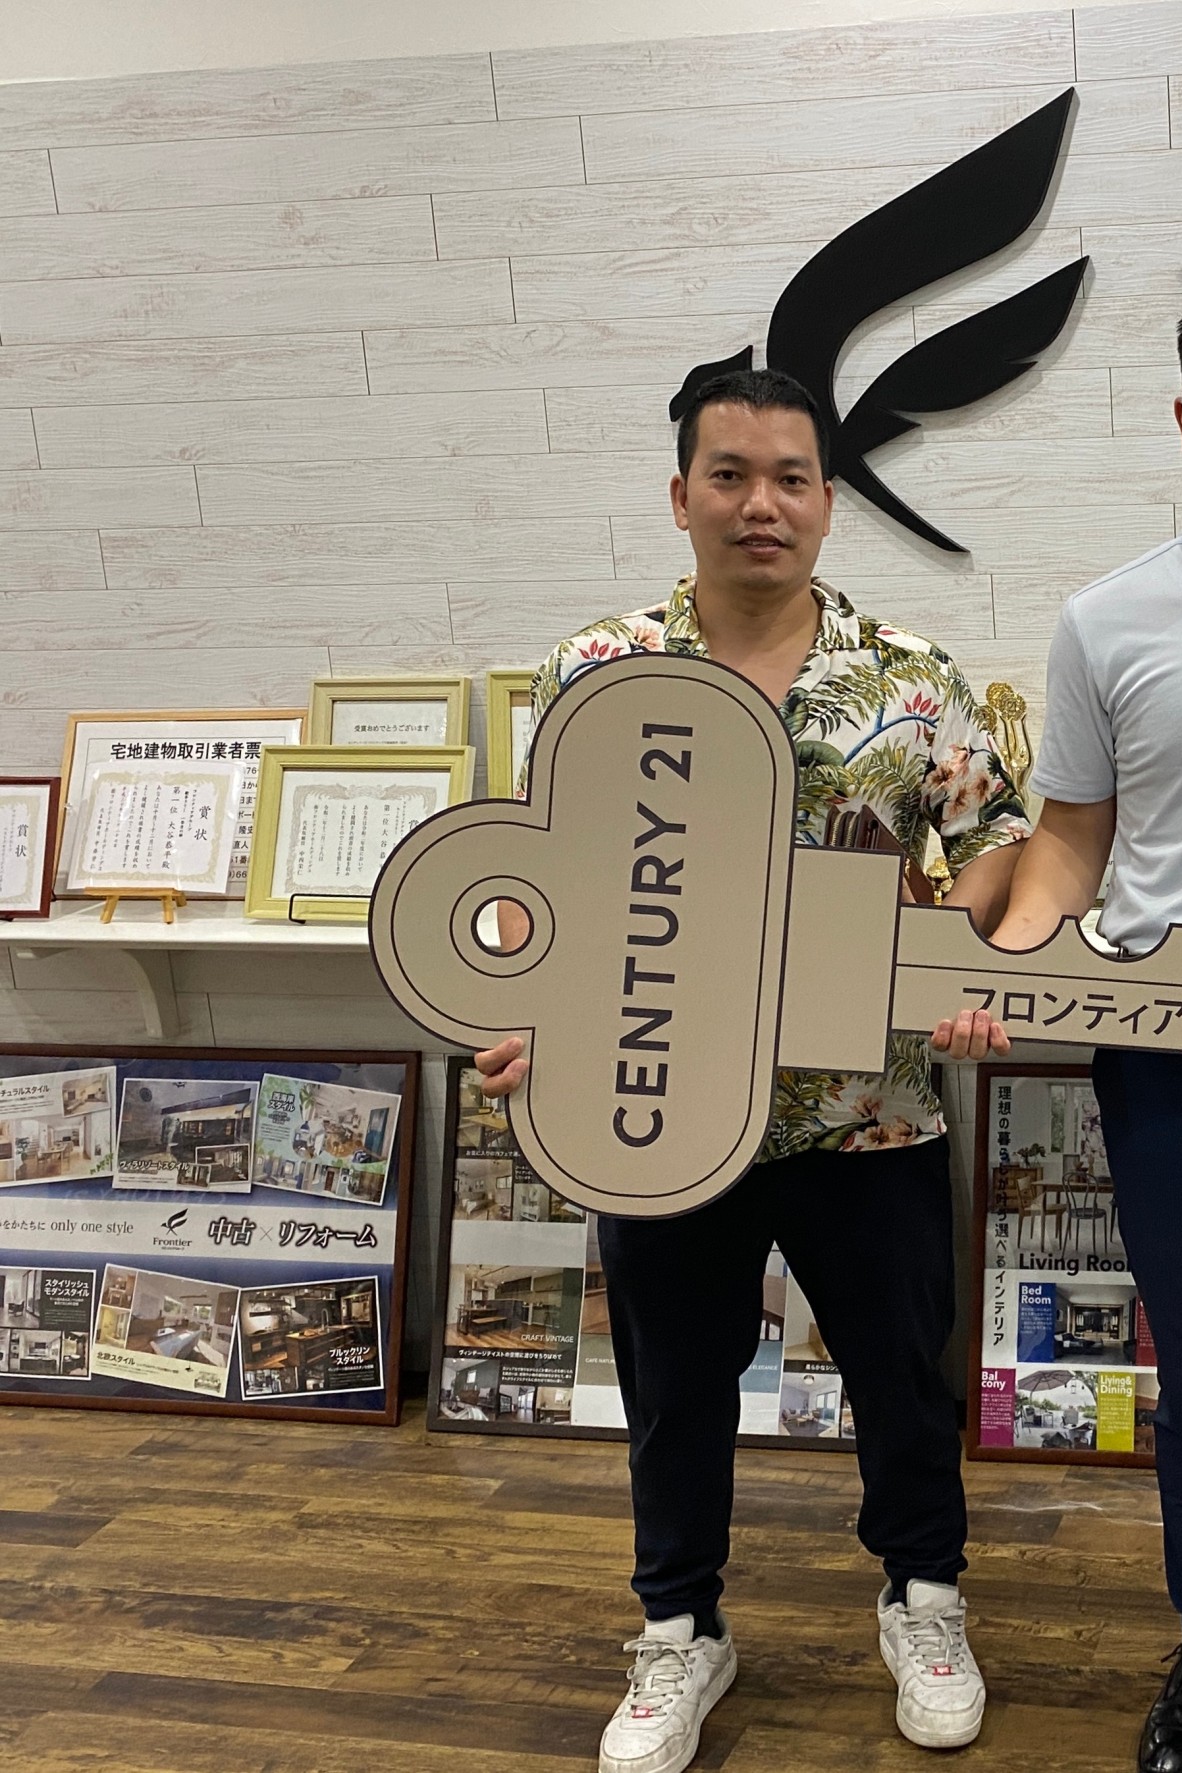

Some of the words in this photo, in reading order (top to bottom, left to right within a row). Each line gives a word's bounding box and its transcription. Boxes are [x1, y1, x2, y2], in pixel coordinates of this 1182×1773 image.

[110, 741, 261, 760] 宅地建物取引業者票
[639, 722, 694, 783] 21
[194, 805, 212, 841] 賞状
[15, 824, 29, 857] 賞状
[612, 801, 687, 1148] CENTURY
[267, 1099, 296, 1112] スタイル
[0, 1219, 46, 1231] をかたちに
[50, 1219, 78, 1235] only
[81, 1222, 103, 1234] one
[106, 1221, 134, 1237] style
[152, 1236, 193, 1248] Frontier
[1019, 1252, 1080, 1276] Living
[1086, 1254, 1130, 1273] Roo
[44, 1278, 90, 1289] スタイリッシュ
[43, 1287, 90, 1298] モダンスタイル
[1021, 1285, 1043, 1296] Bed
[1021, 1294, 1052, 1305] Room
[520, 1334, 544, 1342] CRAFT
[545, 1335, 575, 1343] VINTAGE
[335, 1355, 365, 1366] スタイル
[981, 1371, 998, 1381] Bal
[1100, 1375, 1132, 1387] Living&
[981, 1379, 1006, 1391] cony
[1100, 1385, 1133, 1398] Dining
